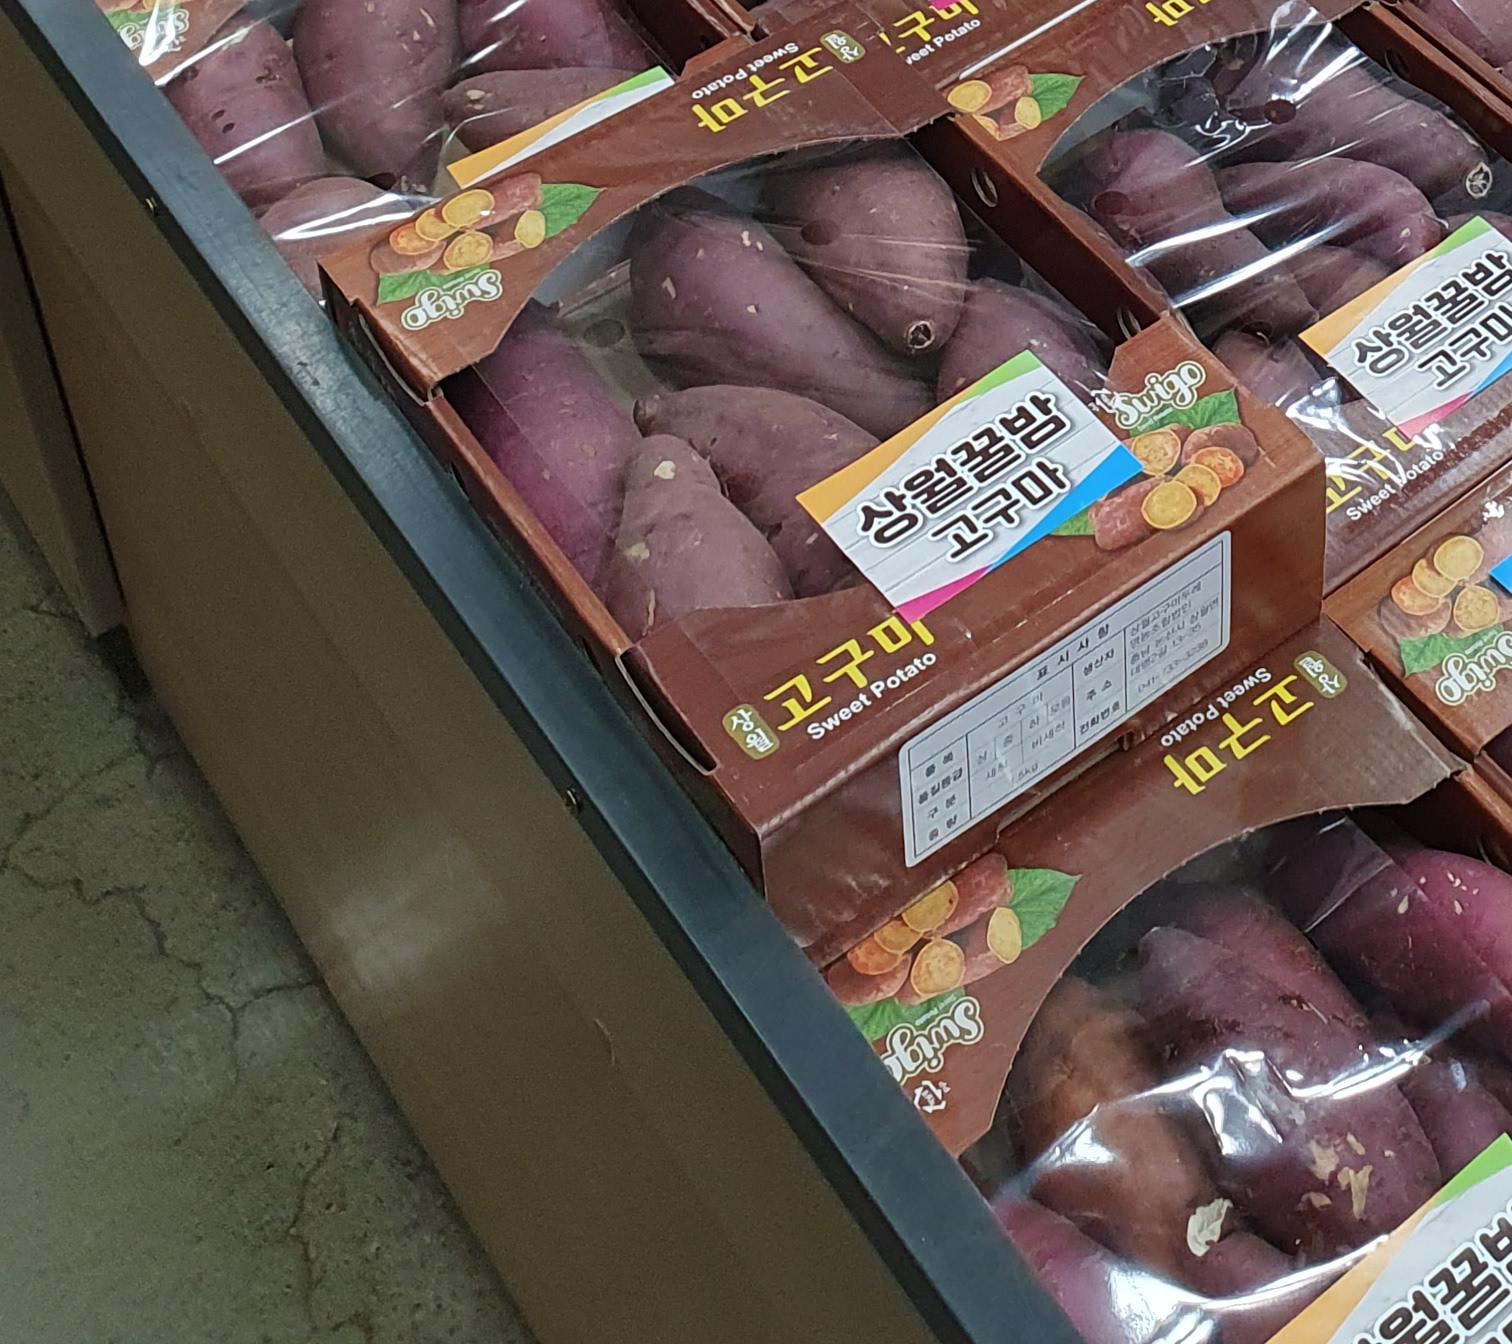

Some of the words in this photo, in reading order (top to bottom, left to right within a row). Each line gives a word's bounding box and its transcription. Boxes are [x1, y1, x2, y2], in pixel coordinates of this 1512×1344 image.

[747, 41, 801, 78] Sweet
[933, 17, 982, 49] Potato
[690, 65, 749, 101] Potato
[691, 47, 835, 133] 고구마
[401, 269, 504, 331] Swigo
[1115, 360, 1207, 429] Swigo
[858, 393, 1072, 547] 상월꿀밤
[1346, 479, 1397, 521] Sweet
[929, 459, 1071, 563] 고구마
[763, 612, 935, 732] 고구마
[806, 692, 873, 740] Sweet
[869, 652, 937, 697] Potato
[1215, 665, 1273, 710] Sweet
[1160, 697, 1220, 748] Potato
[1163, 674, 1316, 795] 고구마
